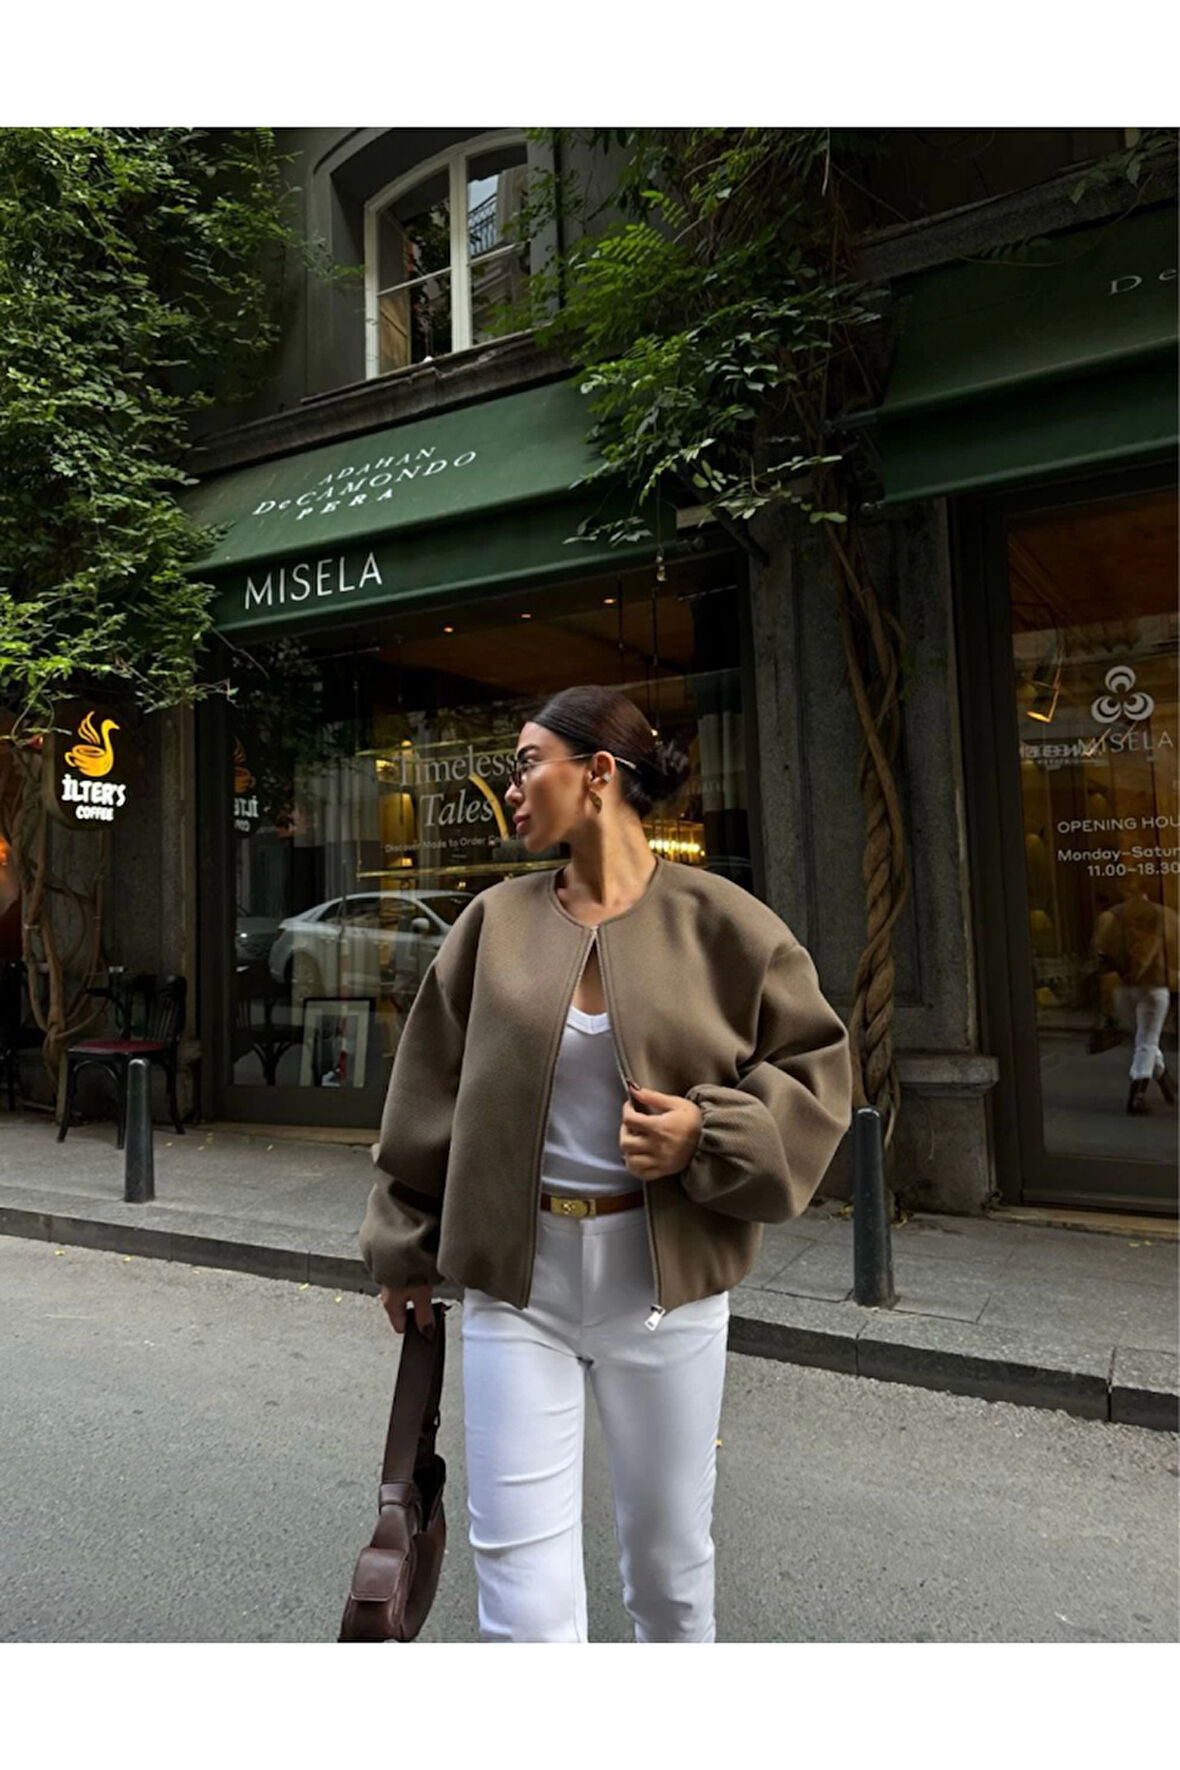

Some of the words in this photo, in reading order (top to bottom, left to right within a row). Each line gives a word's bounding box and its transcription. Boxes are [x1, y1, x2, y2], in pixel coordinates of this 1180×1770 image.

[252, 451, 477, 516] DeCAMONDO
[318, 447, 436, 486] ADAHAN
[296, 488, 393, 520] PERA
[245, 552, 383, 610] MISELA
[1078, 731, 1174, 756] MISELA
[391, 744, 516, 787] Timeless
[75, 805, 115, 822] COFFEE
[419, 789, 494, 828] Tales
[1057, 817, 1137, 834] OPENING
